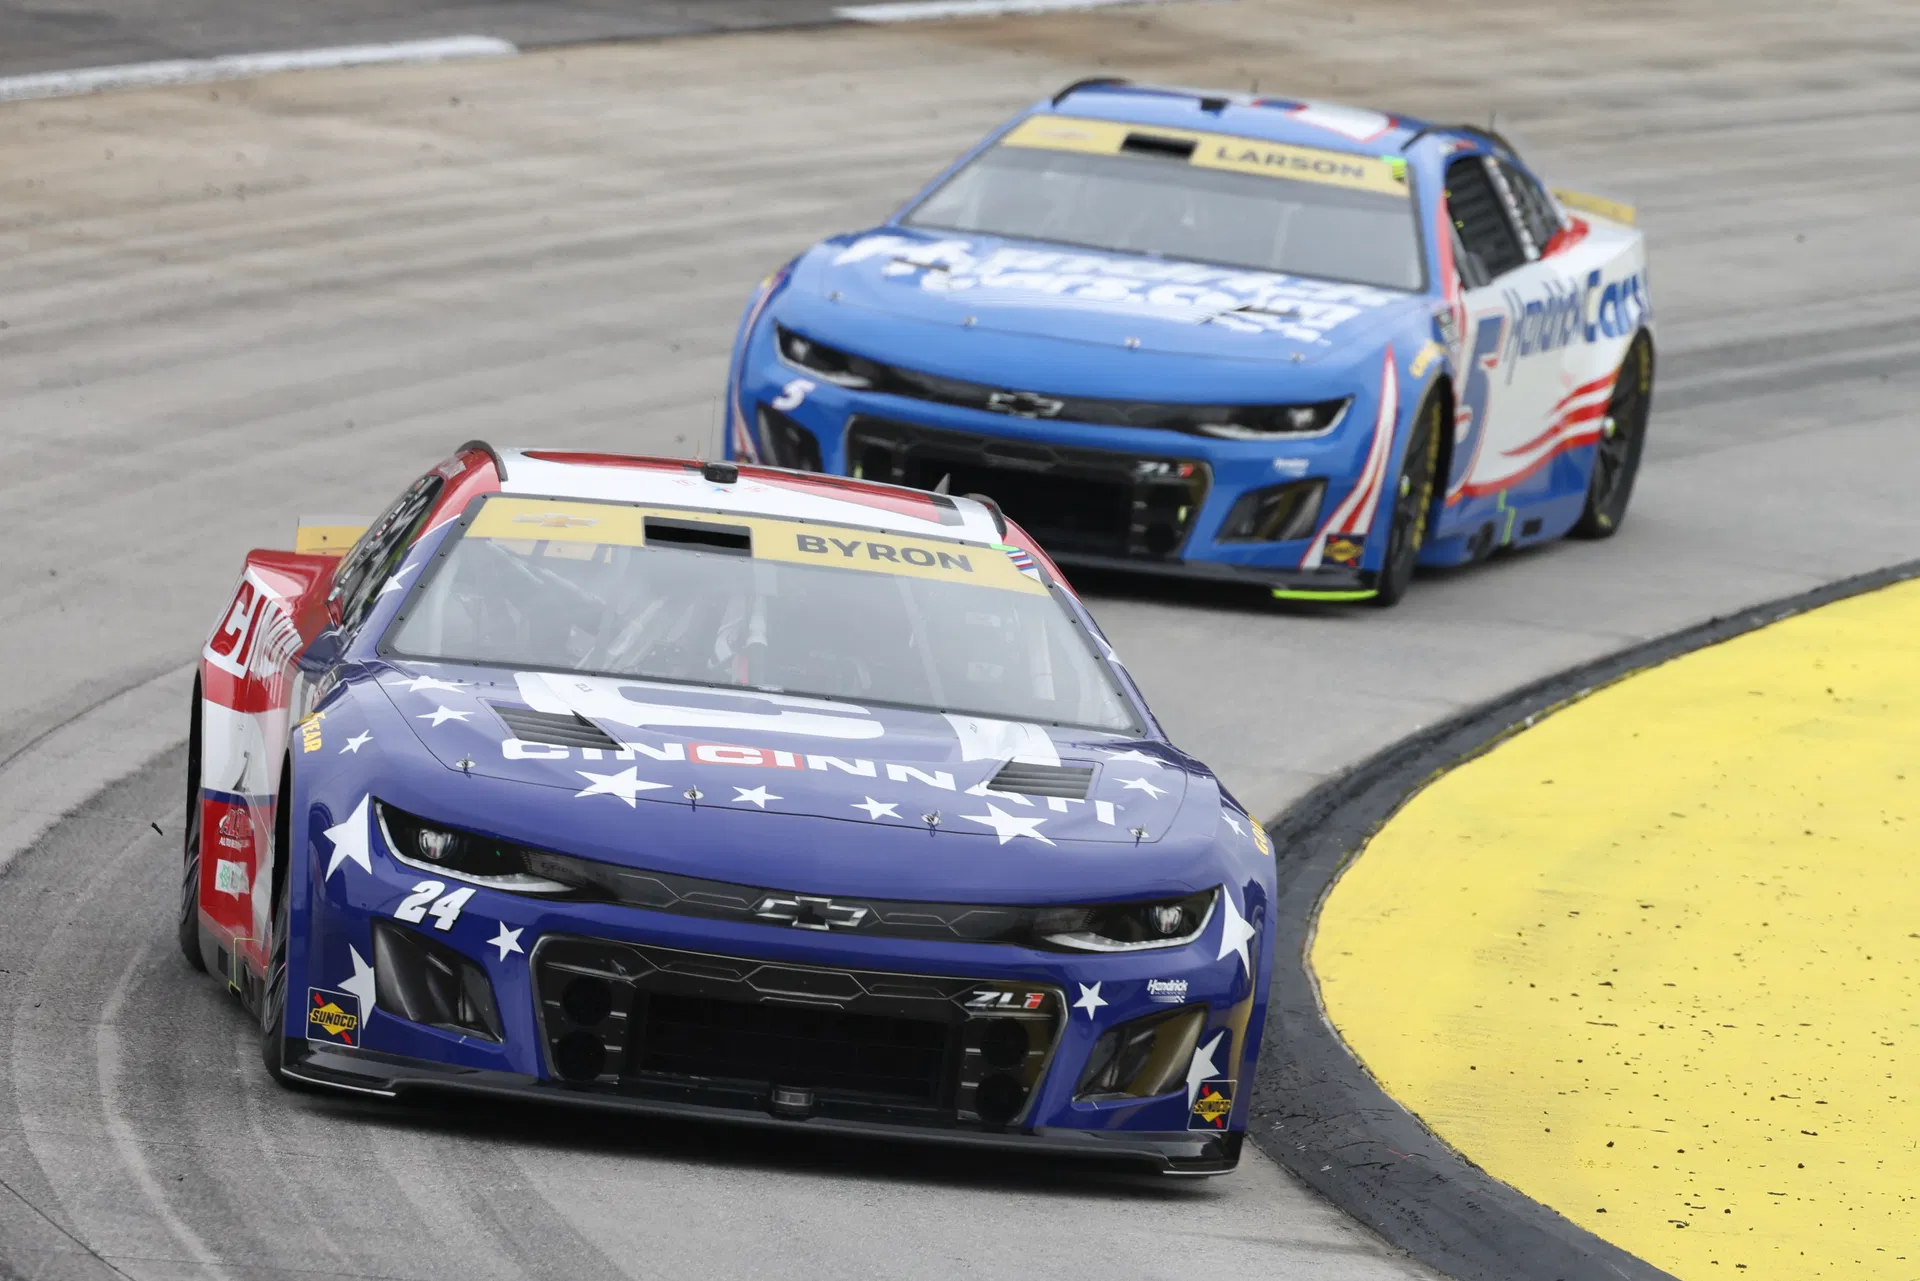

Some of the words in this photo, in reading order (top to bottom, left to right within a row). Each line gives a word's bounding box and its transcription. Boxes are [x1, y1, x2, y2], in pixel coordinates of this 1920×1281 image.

[1214, 146, 1366, 178] LARSON
[772, 379, 816, 411] 5
[796, 534, 974, 573] BYRON
[394, 881, 476, 931] 24
[964, 991, 1045, 1009] ZL1
[311, 1009, 356, 1028] SUNOCO
